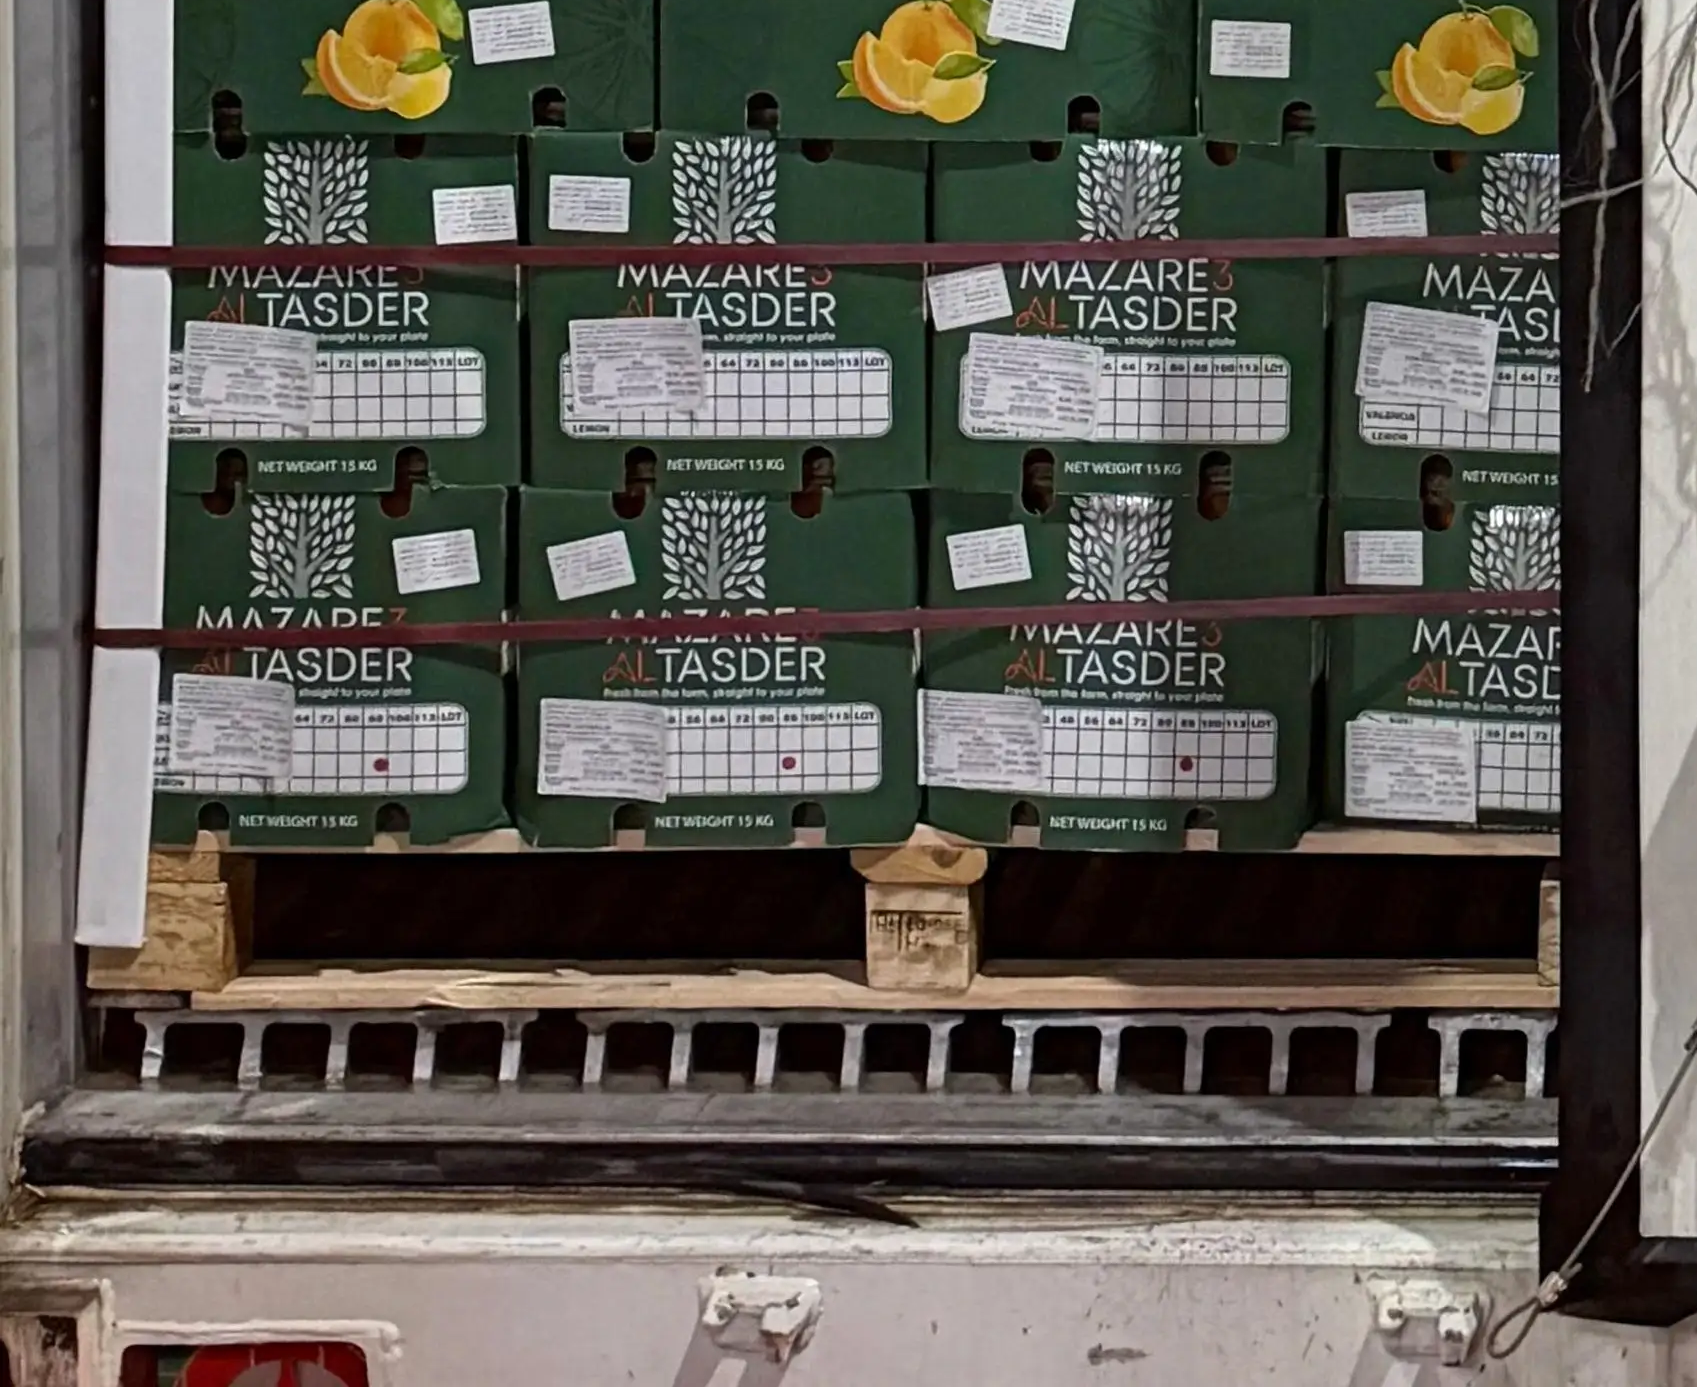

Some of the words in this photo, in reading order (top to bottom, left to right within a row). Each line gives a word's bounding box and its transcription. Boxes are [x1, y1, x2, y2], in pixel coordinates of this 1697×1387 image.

[1064, 461, 1090, 475] NET
[1091, 461, 1143, 475] WEIGHT
[1147, 463, 1161, 475] 15
[1163, 463, 1182, 476] KG
